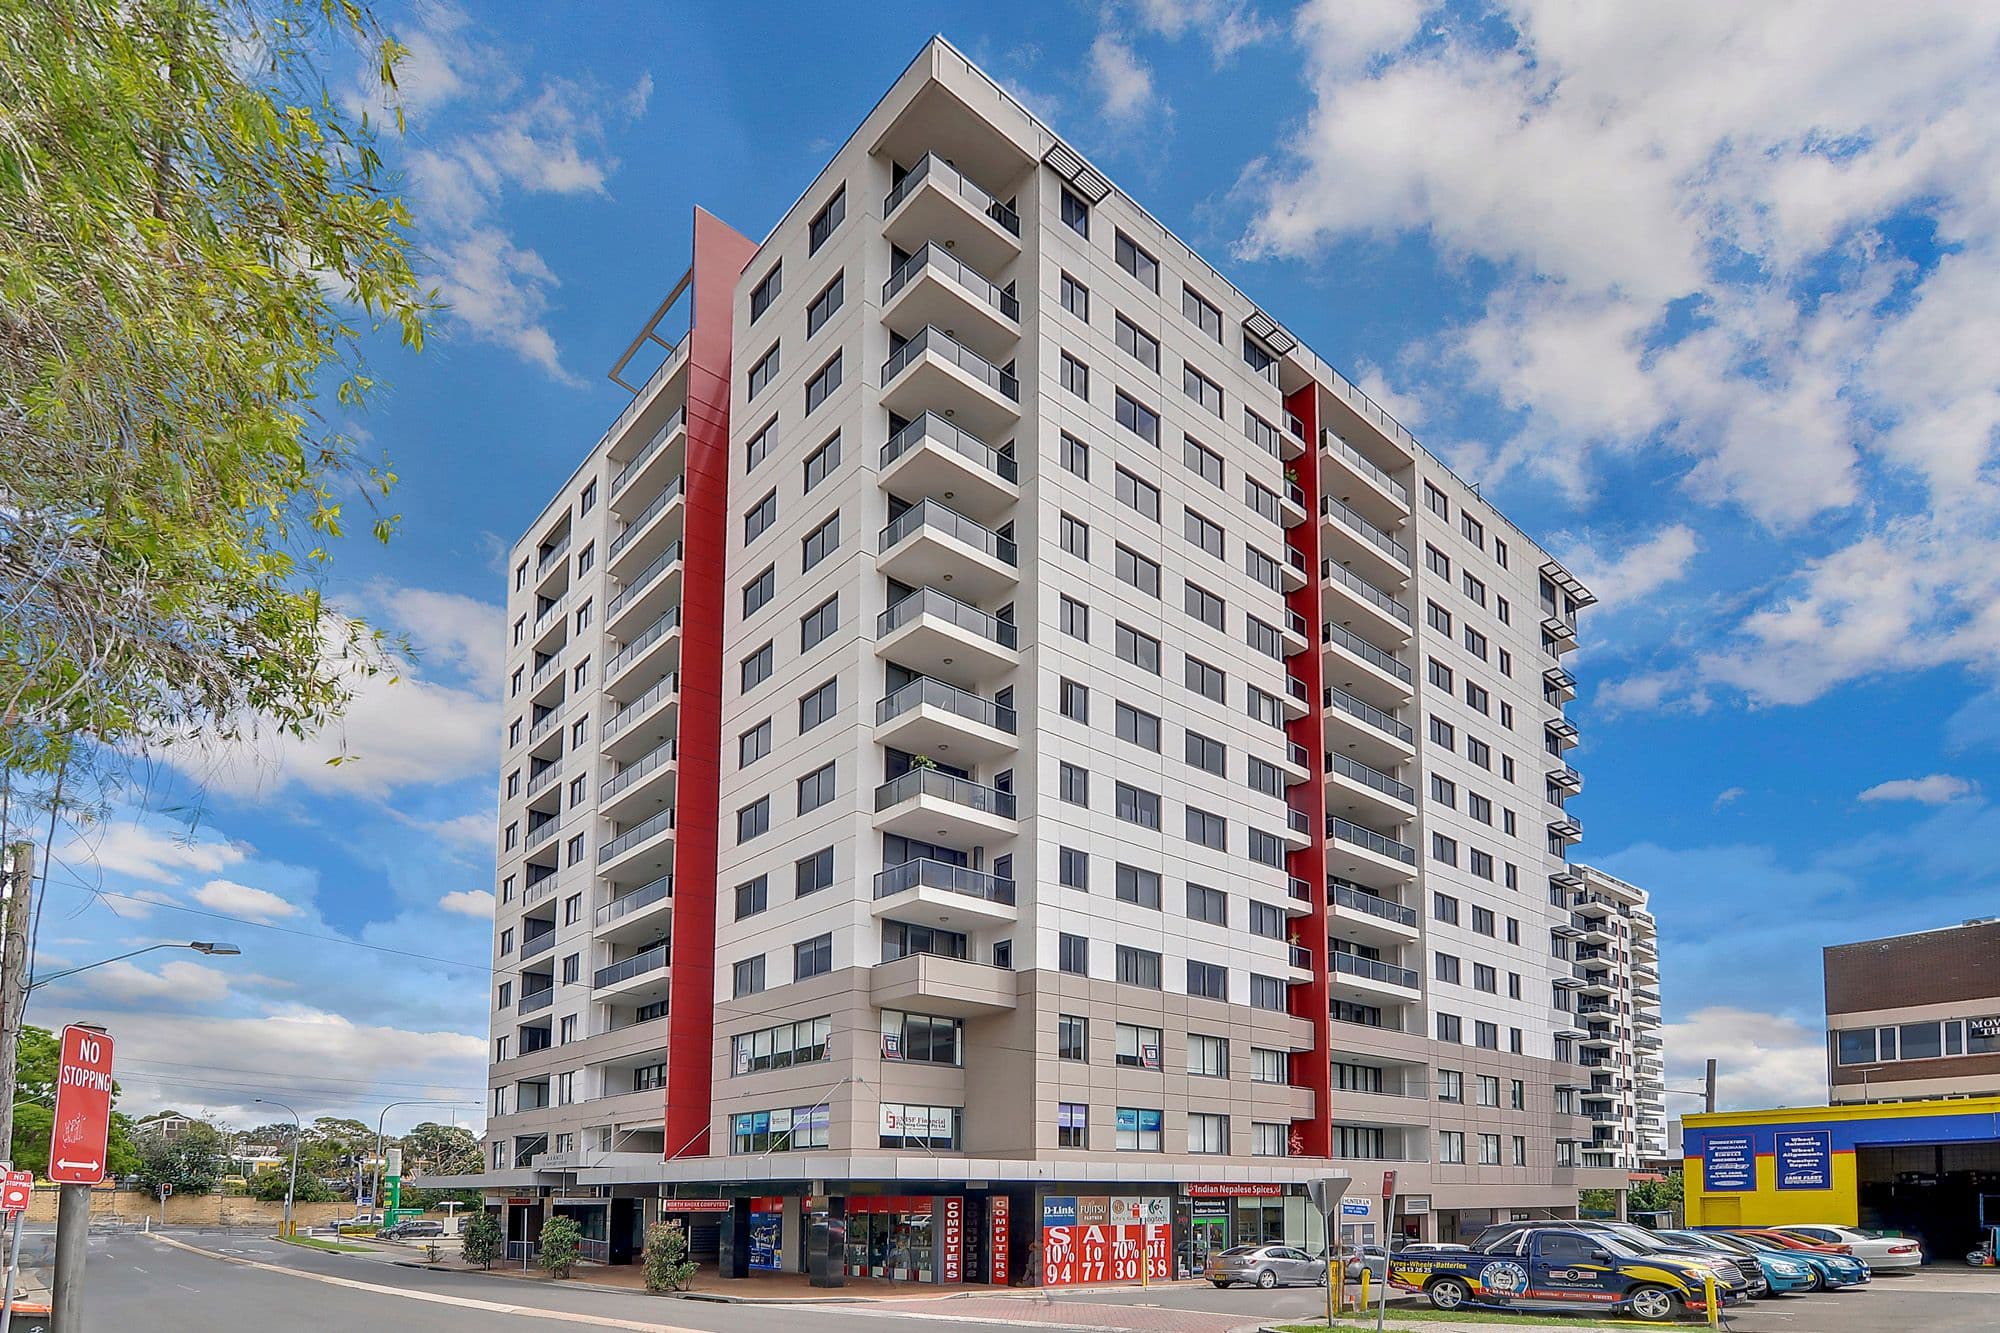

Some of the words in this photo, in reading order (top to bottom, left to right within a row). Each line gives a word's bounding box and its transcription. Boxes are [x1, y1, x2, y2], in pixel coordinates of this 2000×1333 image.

[79, 1038, 100, 1064] NO
[62, 1065, 111, 1092] STOPPING
[1195, 1184, 1219, 1193] Indian
[1219, 1184, 1252, 1195] Nepalese
[1044, 1206, 1074, 1215] D-Link
[1080, 1204, 1107, 1215] FUJITSU
[946, 1201, 959, 1279] COMPUTERS
[995, 1200, 1006, 1278] COMPUTERS
[1044, 1243, 1075, 1265] 10%
[1085, 1243, 1102, 1262] to
[1111, 1240, 1140, 1261] 70%
[1146, 1240, 1166, 1259] off
[1409, 1260, 1433, 1268] Wheels
[1435, 1261, 1468, 1270] Batteries
[1482, 1262, 1502, 1278] BOB
[1504, 1263, 1526, 1283] JANE
